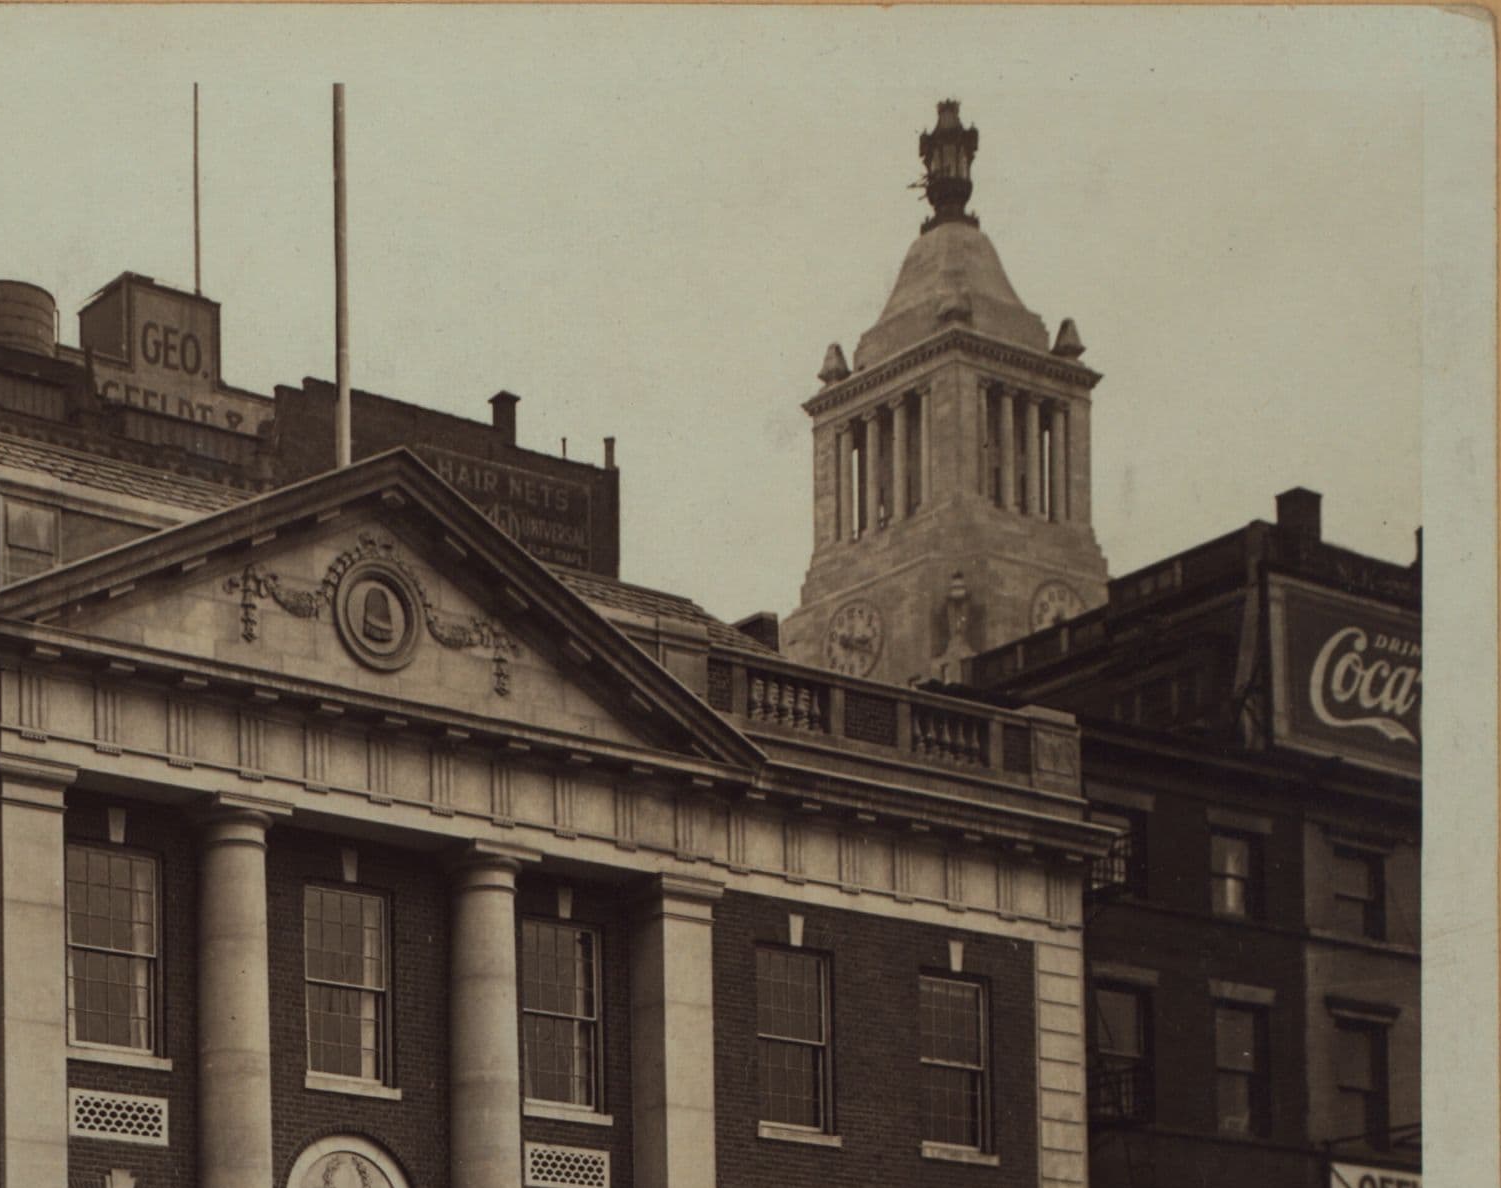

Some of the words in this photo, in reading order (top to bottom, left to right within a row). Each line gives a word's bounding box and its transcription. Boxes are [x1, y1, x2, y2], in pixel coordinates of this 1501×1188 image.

[142, 321, 209, 380] GEO.
[438, 458, 498, 493] HAIR
[509, 475, 570, 512] NETS
